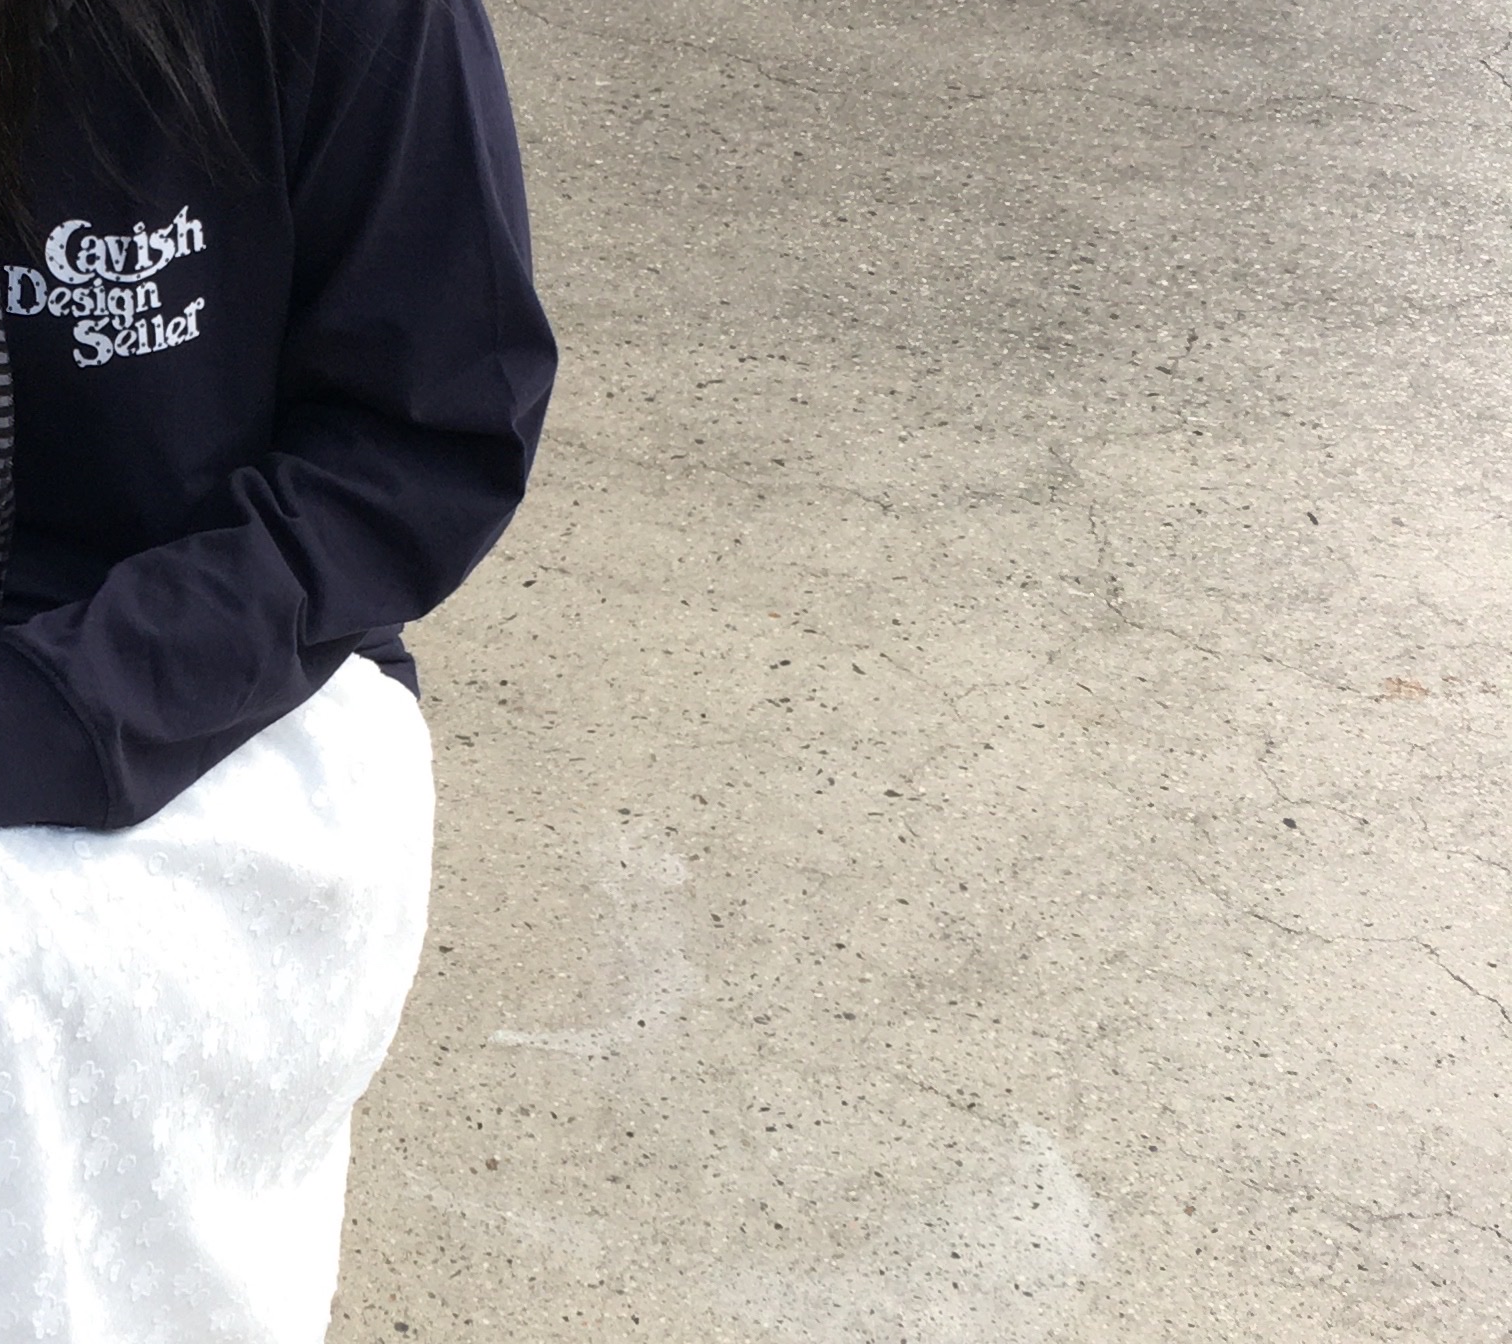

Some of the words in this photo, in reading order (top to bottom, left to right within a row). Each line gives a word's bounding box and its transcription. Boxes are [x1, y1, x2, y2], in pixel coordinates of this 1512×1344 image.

[44, 205, 206, 285] Cavish
[3, 264, 162, 330] Design
[72, 296, 205, 369] Seller
